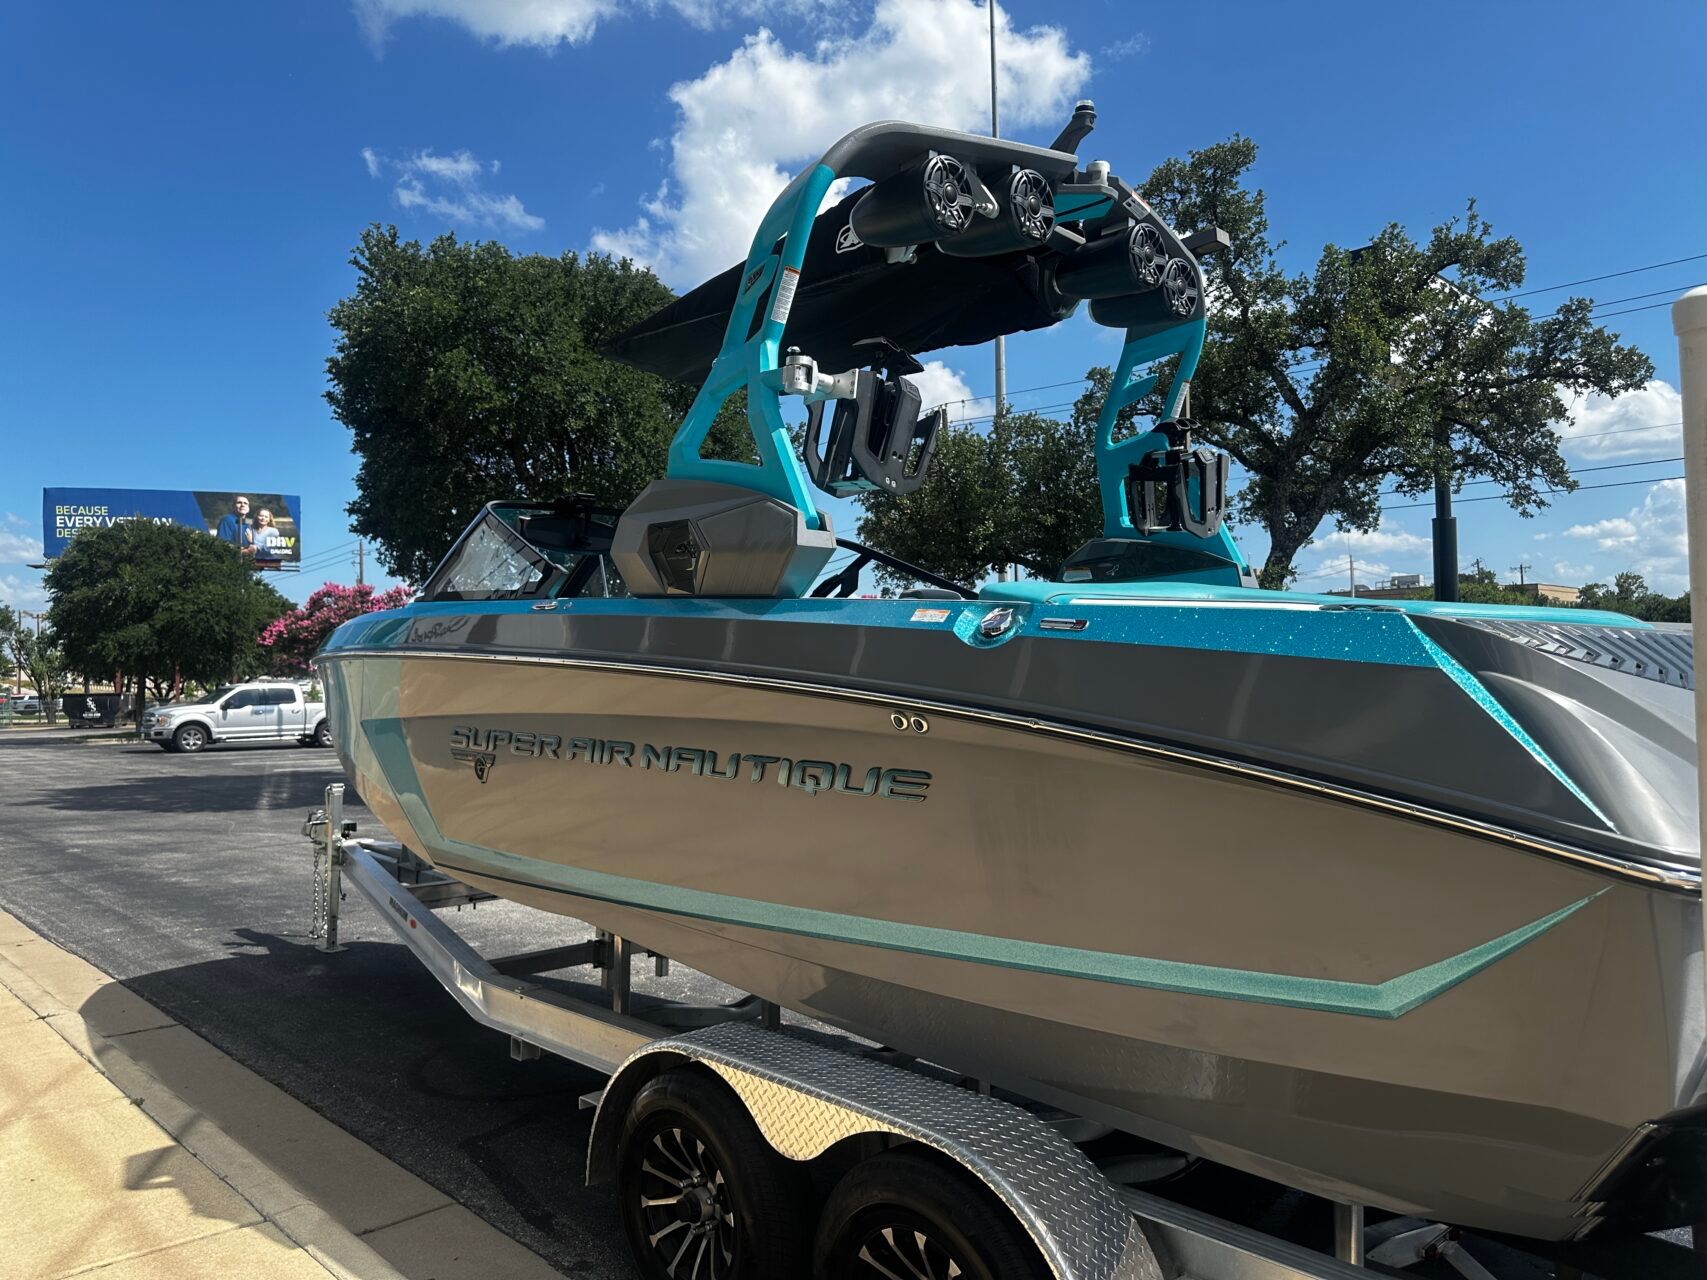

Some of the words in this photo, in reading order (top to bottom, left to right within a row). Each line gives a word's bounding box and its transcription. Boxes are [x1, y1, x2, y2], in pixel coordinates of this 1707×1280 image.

[55, 505, 109, 515] BECAUSE
[56, 516, 103, 527] EVERY
[266, 536, 295, 547] DAV
[448, 725, 562, 760] SUPER
[565, 736, 636, 768] AIR
[639, 742, 934, 803] NAUTIQUE
